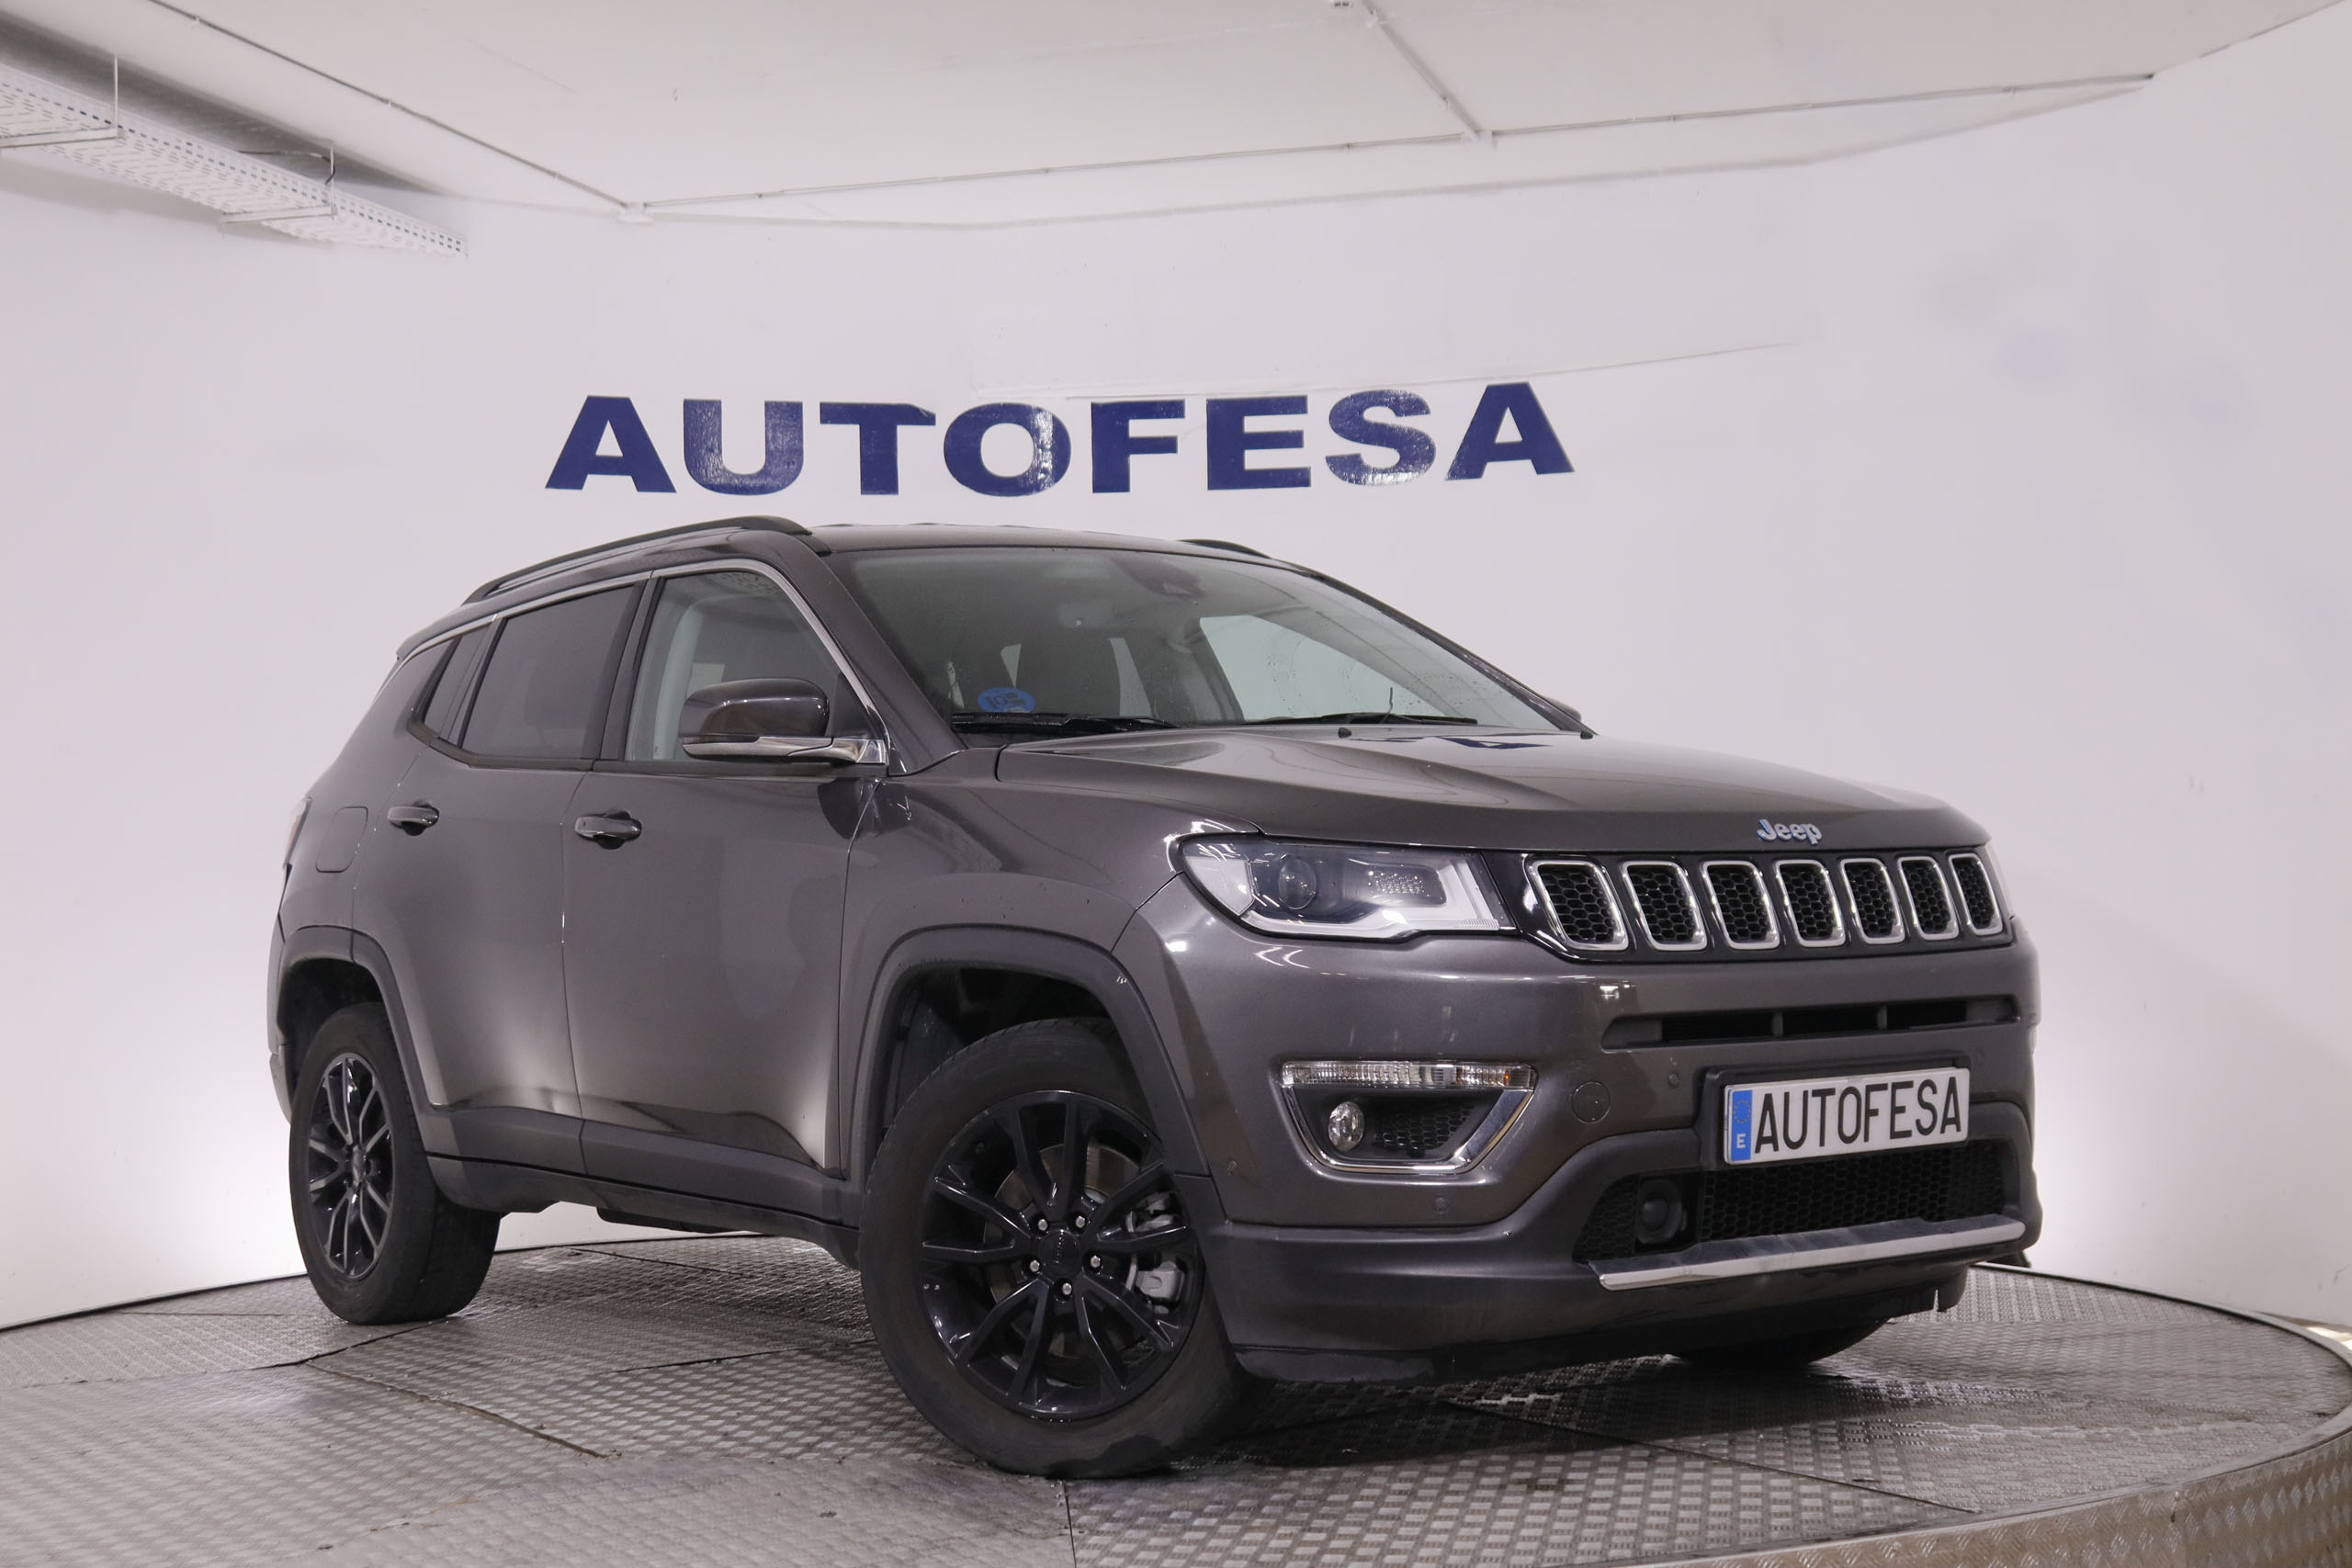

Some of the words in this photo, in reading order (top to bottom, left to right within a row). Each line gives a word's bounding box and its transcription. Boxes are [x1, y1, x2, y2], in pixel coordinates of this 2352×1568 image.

[546, 382, 1574, 496] AUTOFESA
[1757, 818, 1822, 845] Jeep
[1736, 1134, 1747, 1149] E
[1755, 1077, 1962, 1154] AUTOFESA
